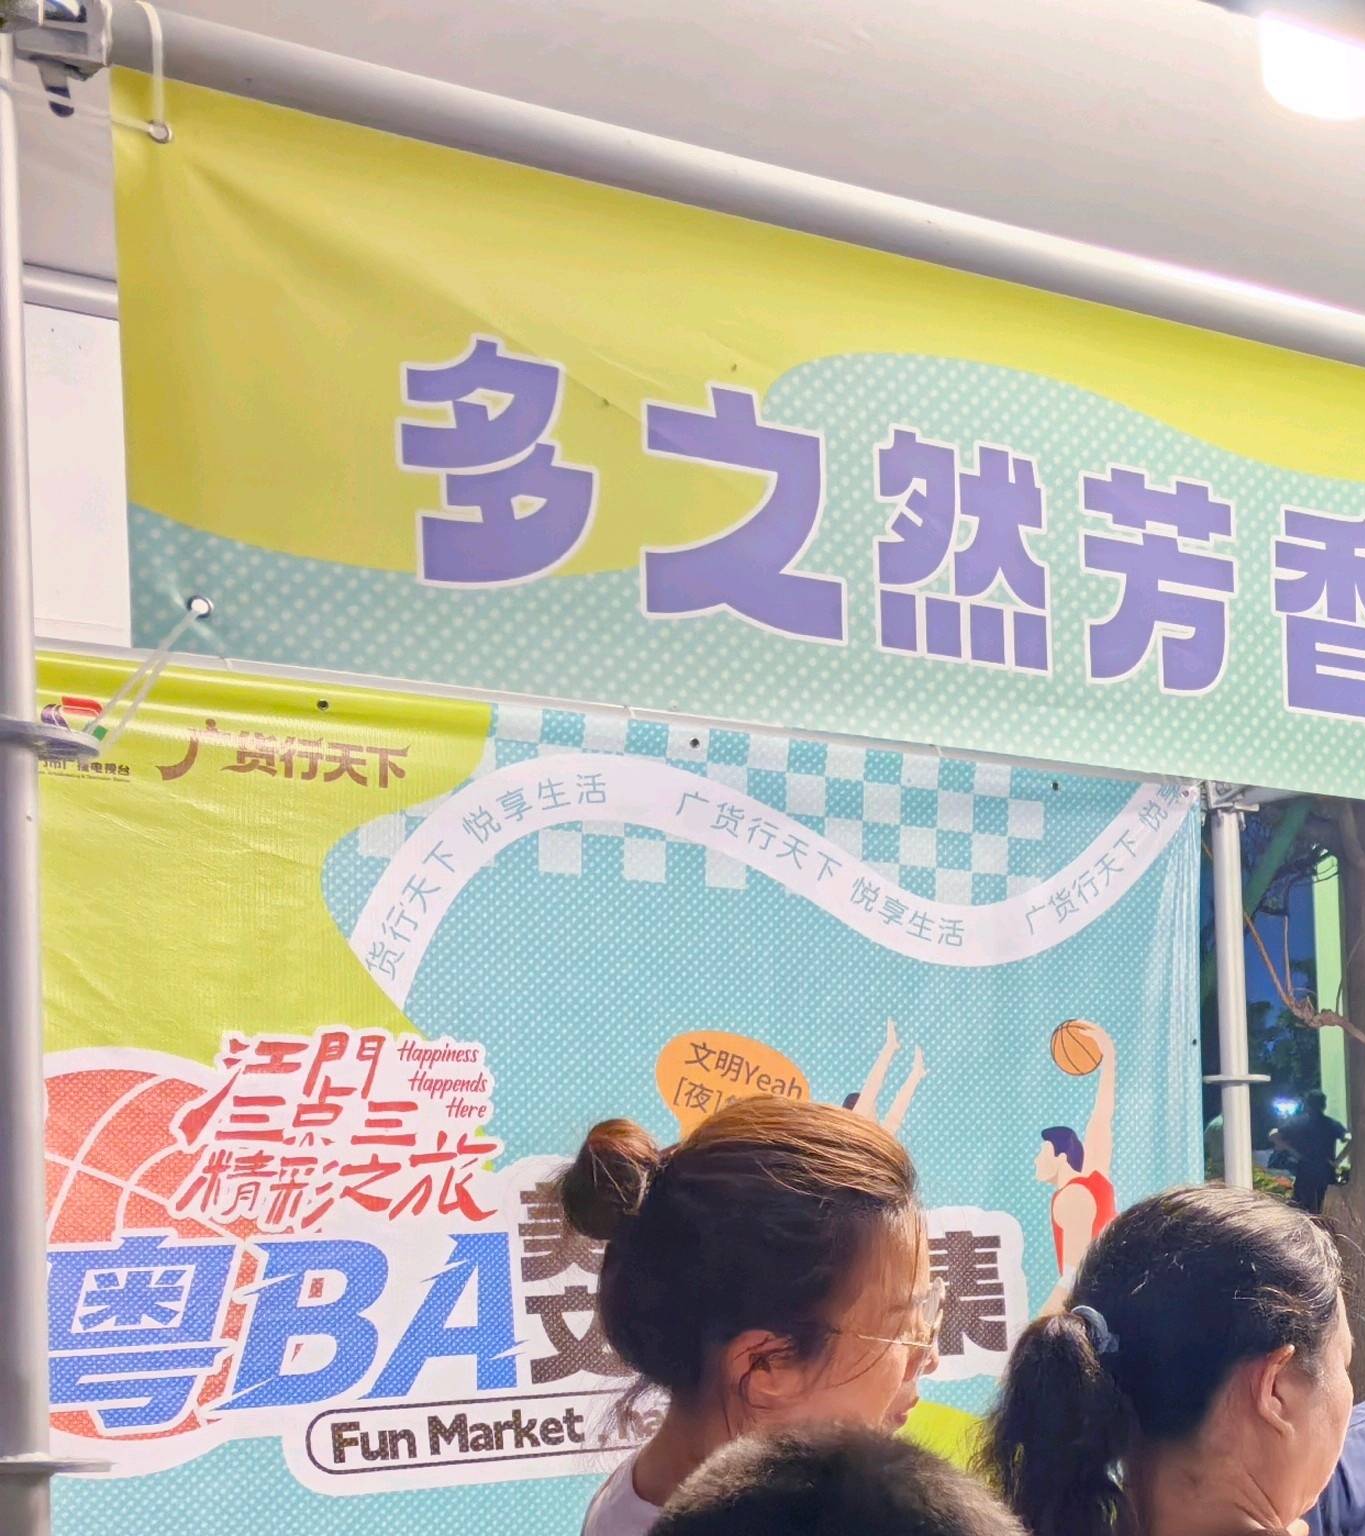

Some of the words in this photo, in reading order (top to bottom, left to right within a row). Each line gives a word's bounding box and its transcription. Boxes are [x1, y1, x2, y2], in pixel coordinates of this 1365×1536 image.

[154, 718, 412, 789] 广货行天下
[462, 772, 607, 844] 悦享生活
[675, 791, 842, 881] 广货行天下
[850, 876, 965, 947] 悦享生活
[1025, 829, 1137, 935] 广货行天下
[397, 1040, 480, 1070] Happiness
[684, 1042, 803, 1100] 文明Yeah
[408, 1070, 488, 1099] Happends
[445, 1097, 487, 1118] Here
[47, 1232, 527, 1430] 粤BA
[330, 1418, 418, 1465] Fun
